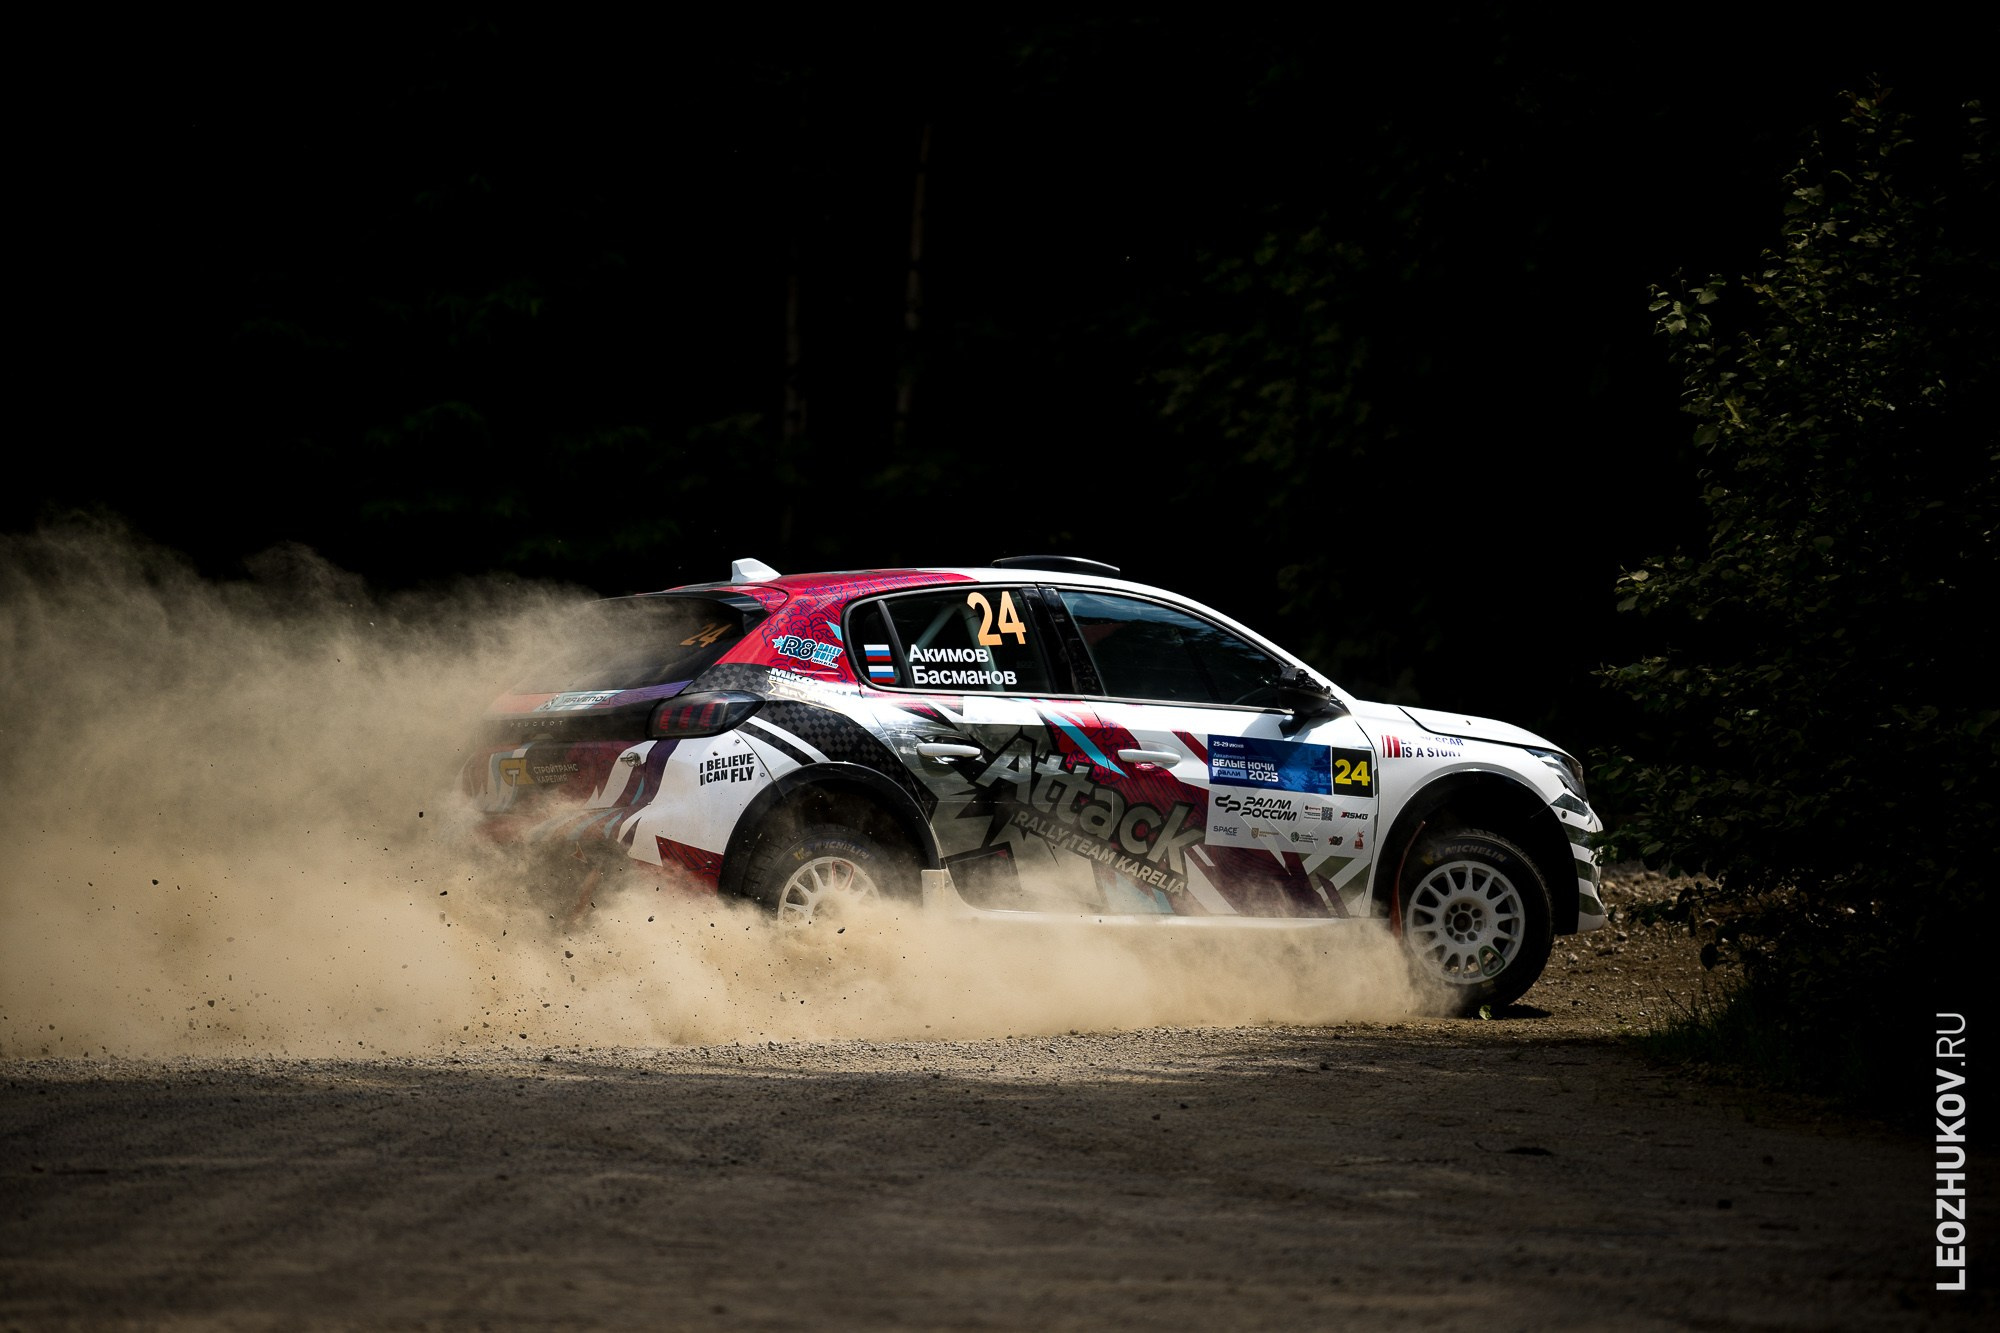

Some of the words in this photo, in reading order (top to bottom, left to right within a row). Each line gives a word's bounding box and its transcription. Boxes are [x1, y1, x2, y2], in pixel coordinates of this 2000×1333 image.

[967, 591, 1026, 646] 24
[680, 623, 733, 648] 24
[780, 636, 815, 659] R8
[909, 644, 989, 663] Акимов
[912, 666, 1017, 685] Басманов
[563, 695, 608, 704] RAVENOL
[1401, 746, 1413, 758] IS
[1416, 747, 1425, 758] A
[533, 763, 579, 775] СТРОЙТРАНС
[706, 752, 755, 771] BELIEVE
[1212, 758, 1246, 769] БЕЛЫЕ
[1247, 761, 1275, 772] НОЧИ
[705, 769, 728, 784] CAN
[730, 766, 755, 783] FLY
[1248, 770, 1279, 783] 2025
[1334, 758, 1371, 787] 24
[975, 736, 1206, 875] Attack
[1243, 796, 1292, 810] РАЛЛИ
[1240, 807, 1297, 821] РОССИИ
[1213, 826, 1238, 834] SPACE
[1014, 810, 1070, 843] RALLY
[1068, 833, 1116, 869] TEAM
[1114, 854, 1188, 898] KARELIA
[1445, 844, 1507, 862] MICHELIN
